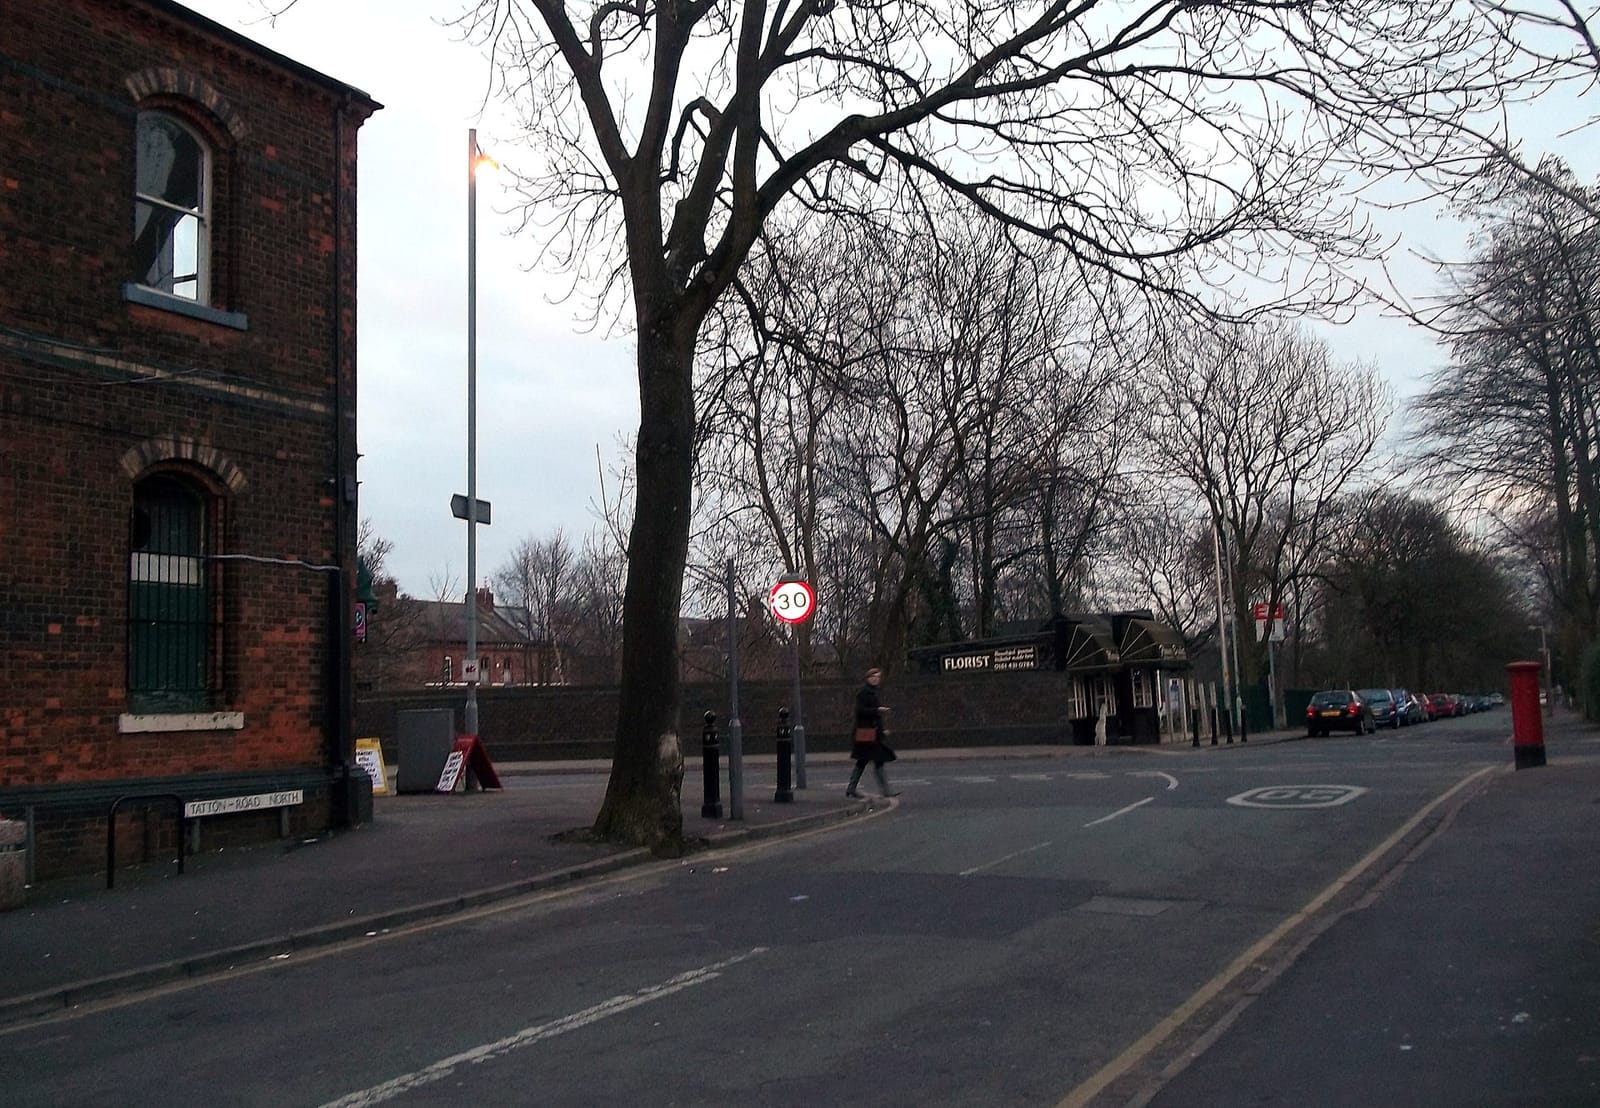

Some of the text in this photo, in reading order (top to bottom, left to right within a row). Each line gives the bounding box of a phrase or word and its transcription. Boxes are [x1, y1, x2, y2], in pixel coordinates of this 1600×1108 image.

[778, 592, 806, 610] 30
[944, 655, 990, 670] FLORIST
[269, 791, 299, 805] NORTH
